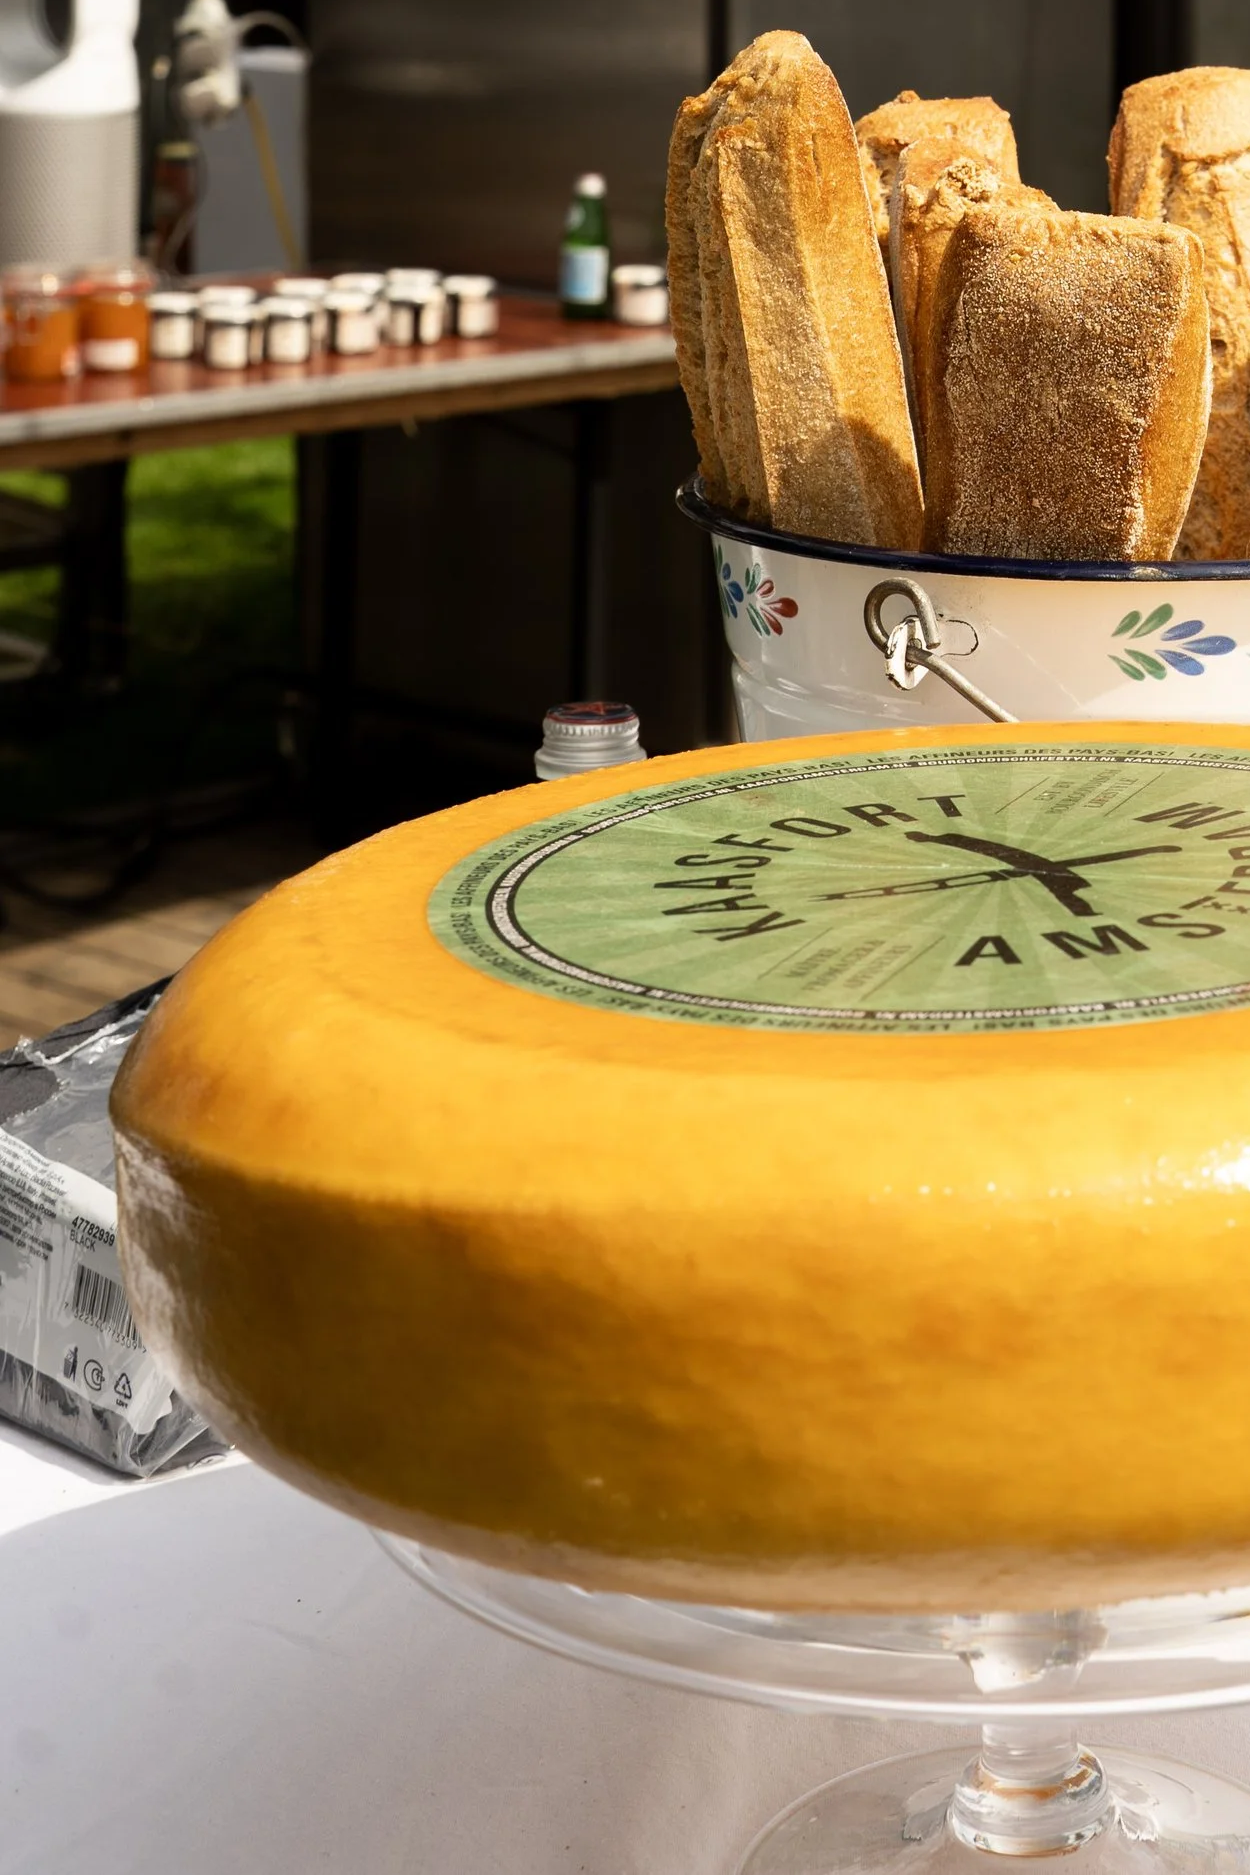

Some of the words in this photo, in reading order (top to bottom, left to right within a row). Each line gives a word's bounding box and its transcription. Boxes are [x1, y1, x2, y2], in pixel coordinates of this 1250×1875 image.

[866, 755, 901, 764] LES
[908, 749, 1016, 760] AFFINEURS
[1068, 748, 1174, 756] PAYS-BAS!
[917, 753, 1115, 768] BOURGONDISCHLIFESTYLE.NL
[1188, 751, 1224, 760] LES
[737, 760, 913, 789] KAASFORTAMSTERDAM.NL
[582, 807, 617, 818] LES
[706, 776, 746, 786] DES
[653, 793, 966, 942] KAASFORT
[69, 1229, 96, 1252] BLACK
[72, 1215, 116, 1247] 47782939
